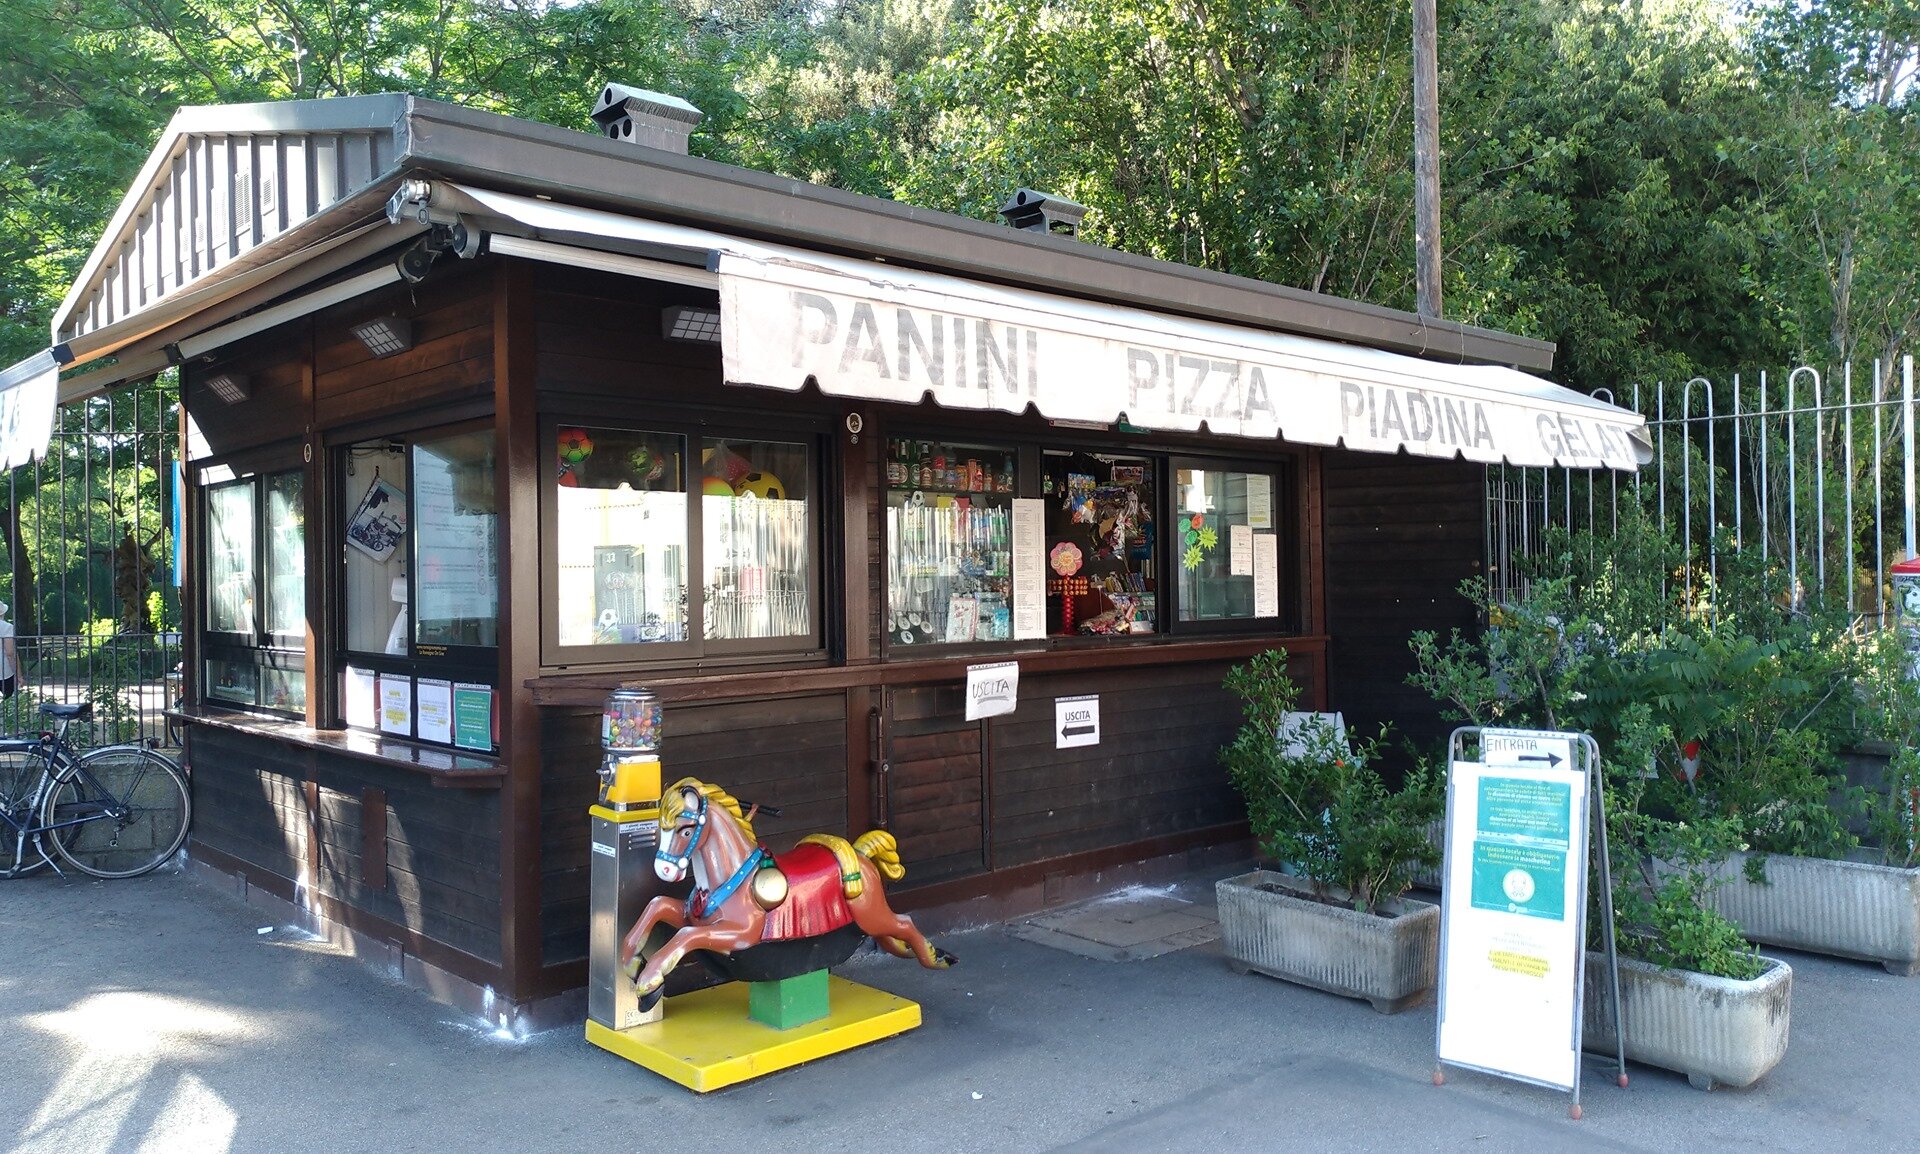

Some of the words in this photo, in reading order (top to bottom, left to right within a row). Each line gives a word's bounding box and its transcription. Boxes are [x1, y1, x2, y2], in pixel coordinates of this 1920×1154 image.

[789, 291, 1038, 398] PANINI
[1126, 346, 1278, 423] PIZZA
[1339, 381, 1496, 450] PIADINA
[972, 678, 1010, 698] USCITA
[1065, 710, 1091, 722] USCITA
[1486, 738, 1538, 752] ENTRATA
